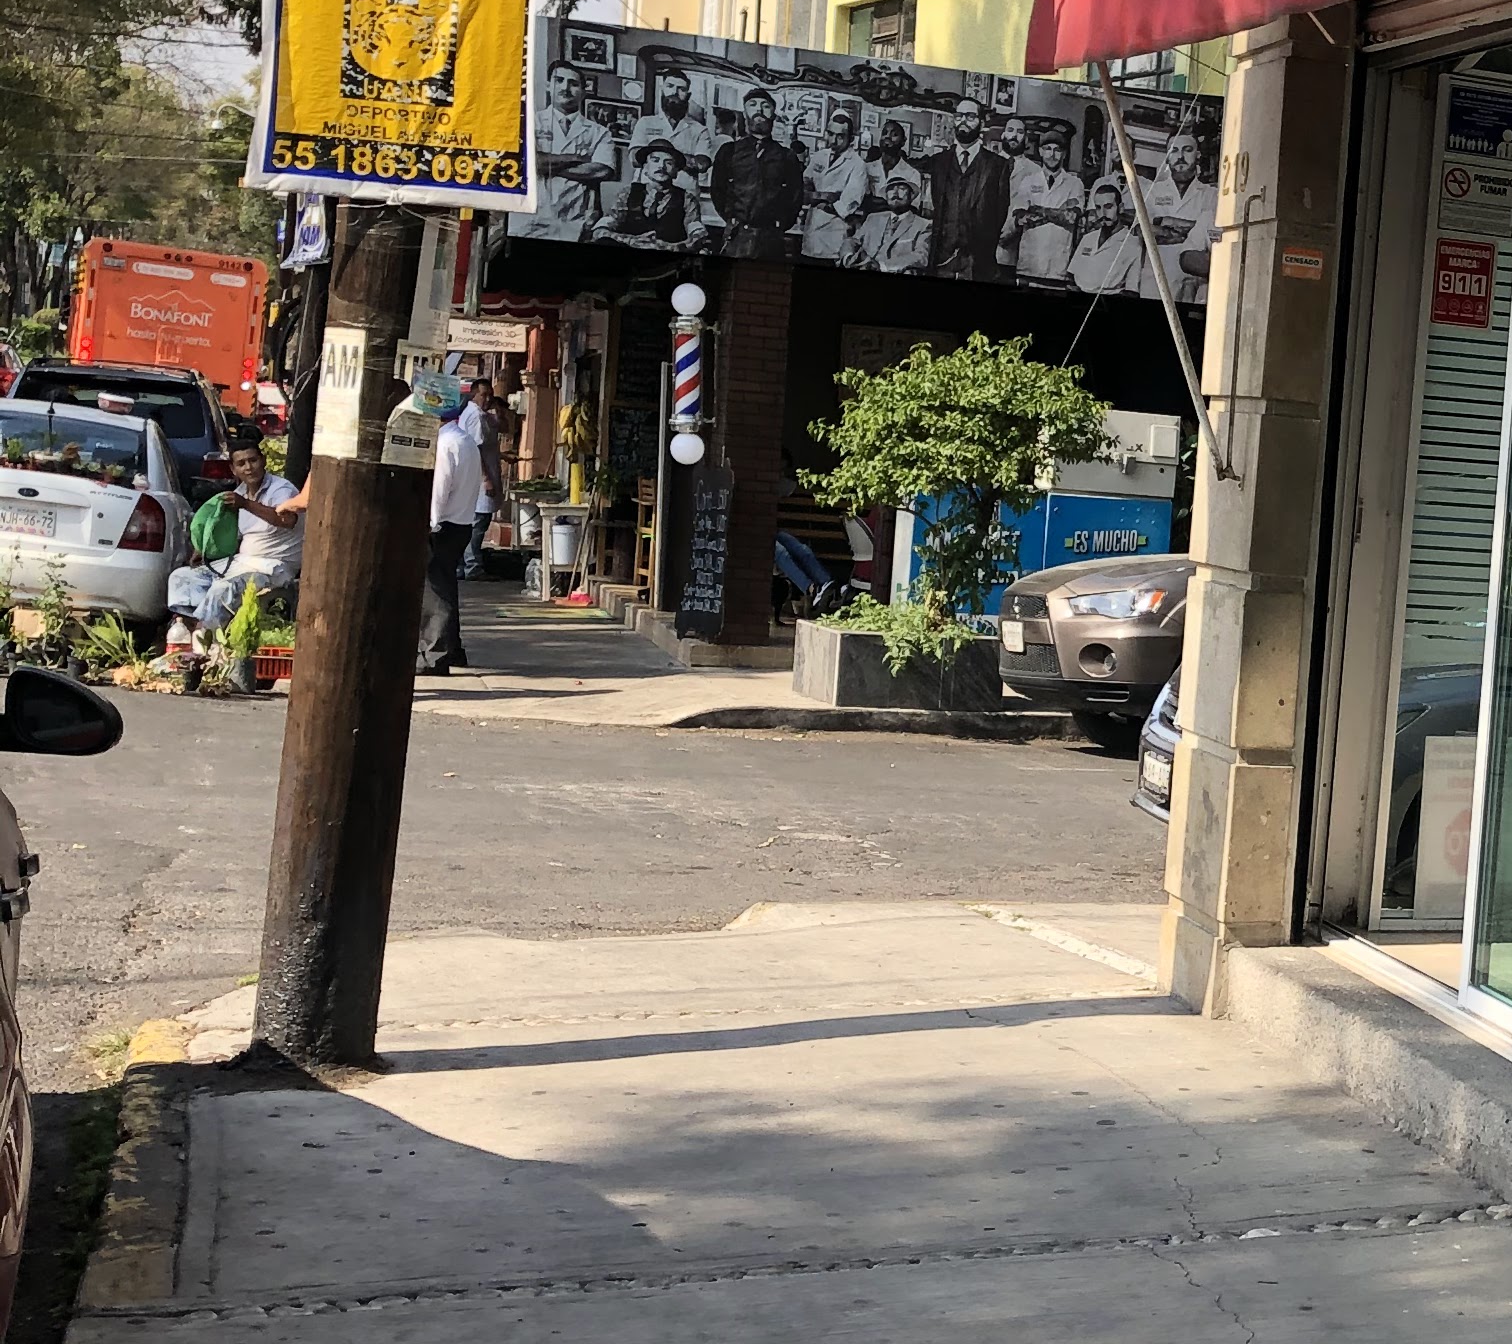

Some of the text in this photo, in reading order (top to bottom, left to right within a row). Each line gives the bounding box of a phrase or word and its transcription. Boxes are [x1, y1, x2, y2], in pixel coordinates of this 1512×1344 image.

[346, 104, 451, 127] DEPORTIVO
[322, 120, 392, 141] MIGUEL
[272, 138, 519, 188] 55 1863 0973
[1284, 256, 1320, 266] CENSADO
[1440, 272, 1484, 296] 911
[130, 302, 213, 327] BONAFONT
[1073, 529, 1138, 553] ES MUCHO
